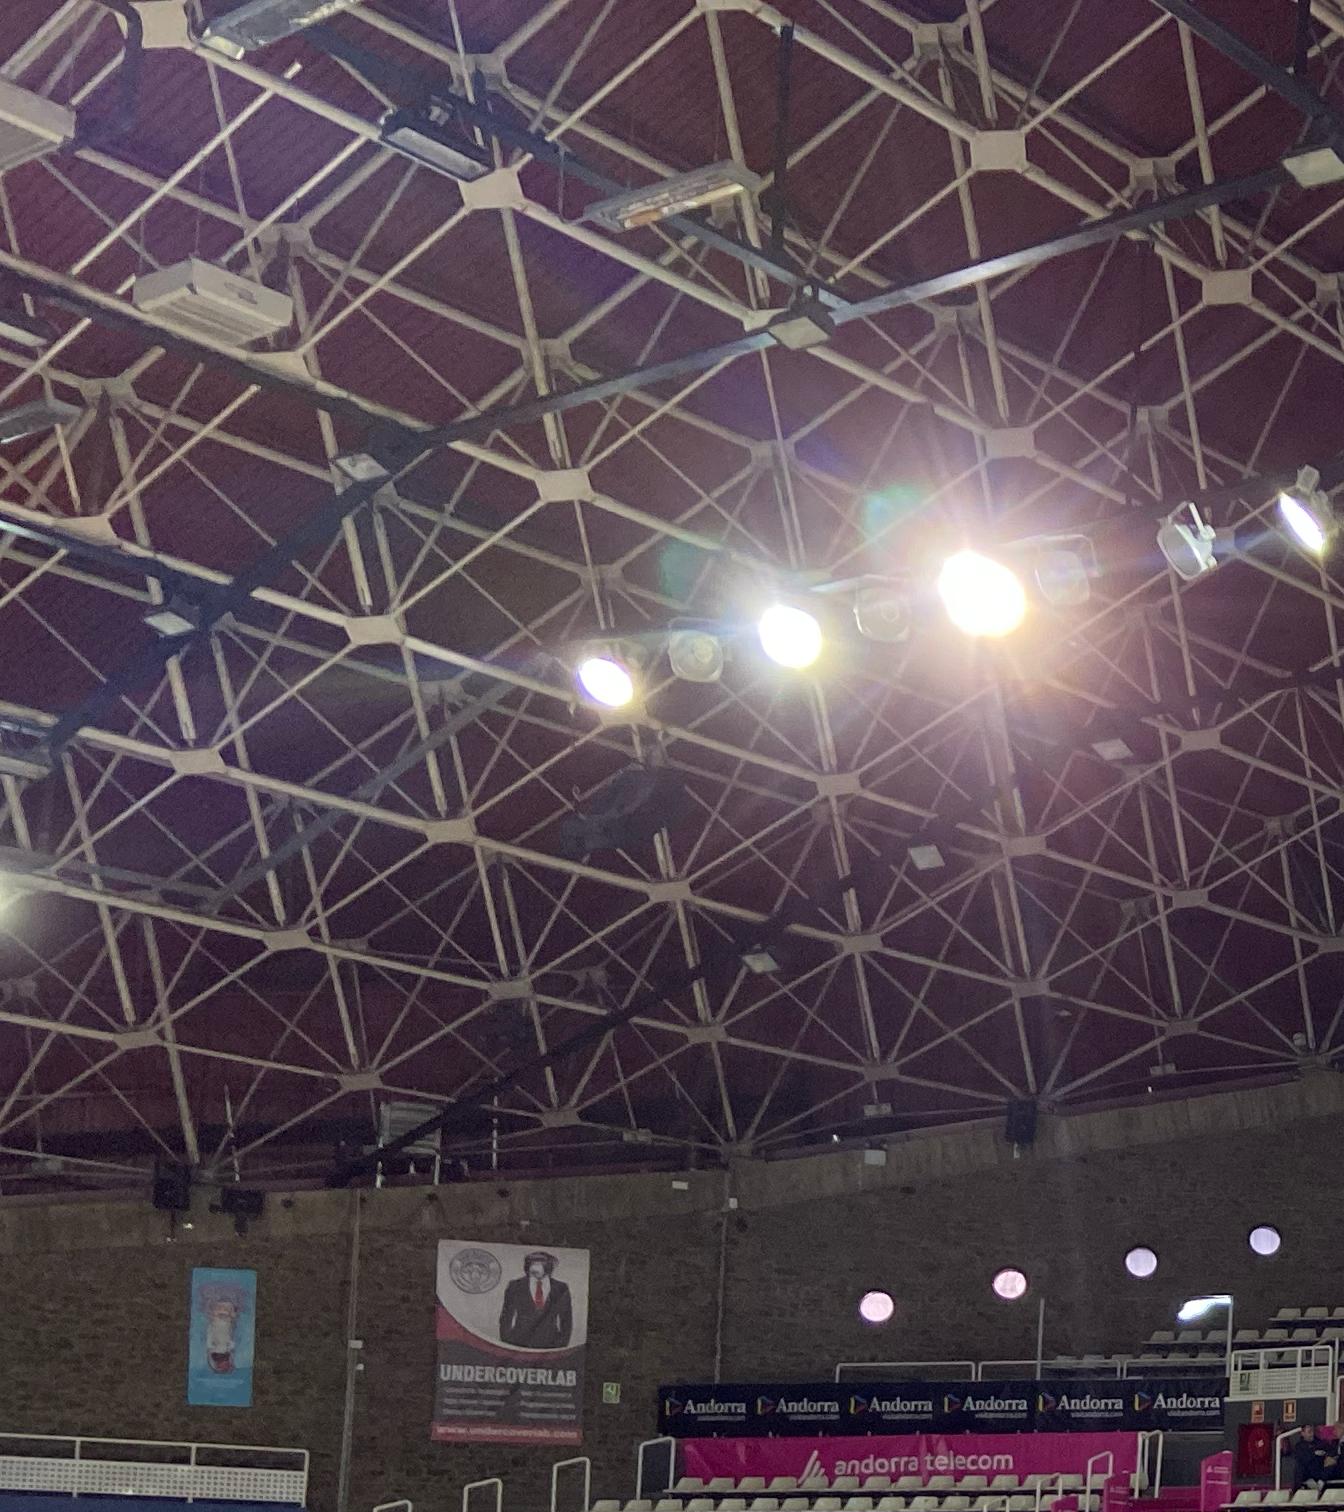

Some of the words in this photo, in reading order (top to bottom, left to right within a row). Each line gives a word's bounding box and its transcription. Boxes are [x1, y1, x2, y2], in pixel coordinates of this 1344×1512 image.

[439, 1363, 577, 1387] UNDERCOVERLAB
[684, 1399, 746, 1414] Andorra
[776, 1398, 839, 1413] Andorra
[869, 1397, 933, 1412] Andorra
[963, 1396, 1027, 1411] Andorra
[1058, 1394, 1123, 1410] Andorra
[1154, 1392, 1220, 1409] Andorra
[835, 1454, 919, 1476] andorra
[925, 1449, 1014, 1471] telecom
